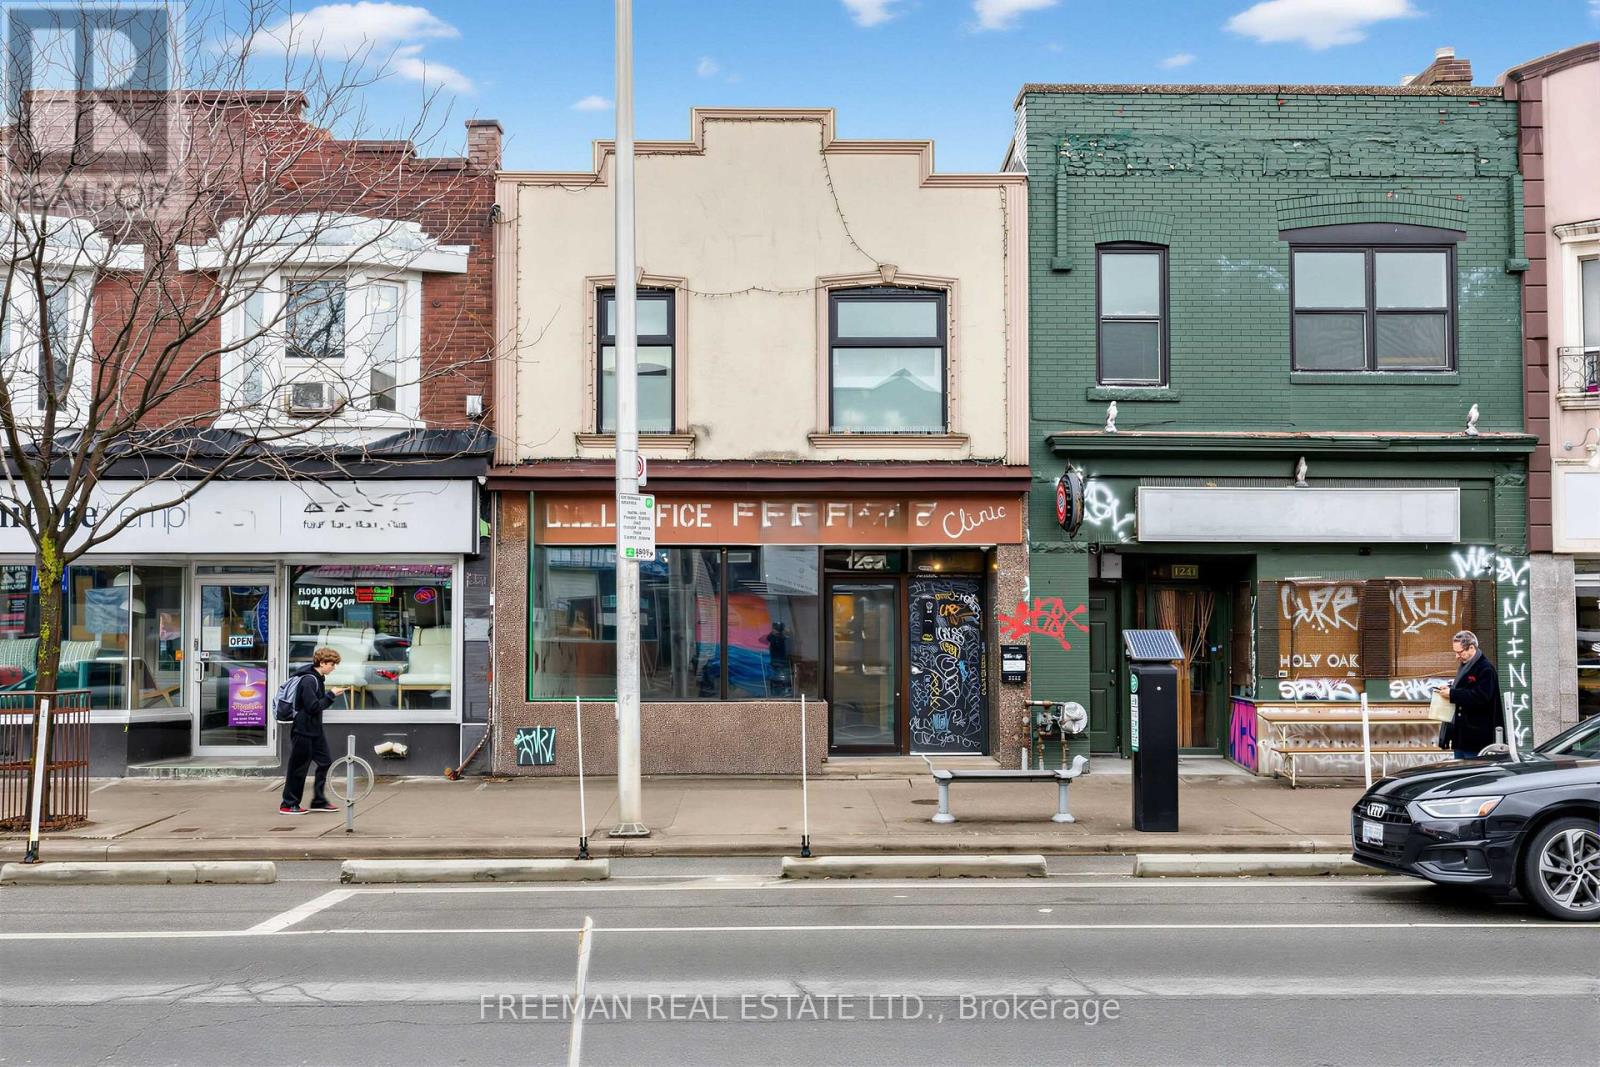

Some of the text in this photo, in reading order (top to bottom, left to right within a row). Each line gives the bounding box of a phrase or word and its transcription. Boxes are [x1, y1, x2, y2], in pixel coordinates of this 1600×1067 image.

[943, 506, 1006, 538] Clinic
[298, 587, 322, 595] FLOOR
[324, 587, 355, 595] MODELS
[310, 596, 343, 610] 40%
[230, 637, 253, 646] OPEN
[1280, 654, 1360, 668] HOLY OAK
